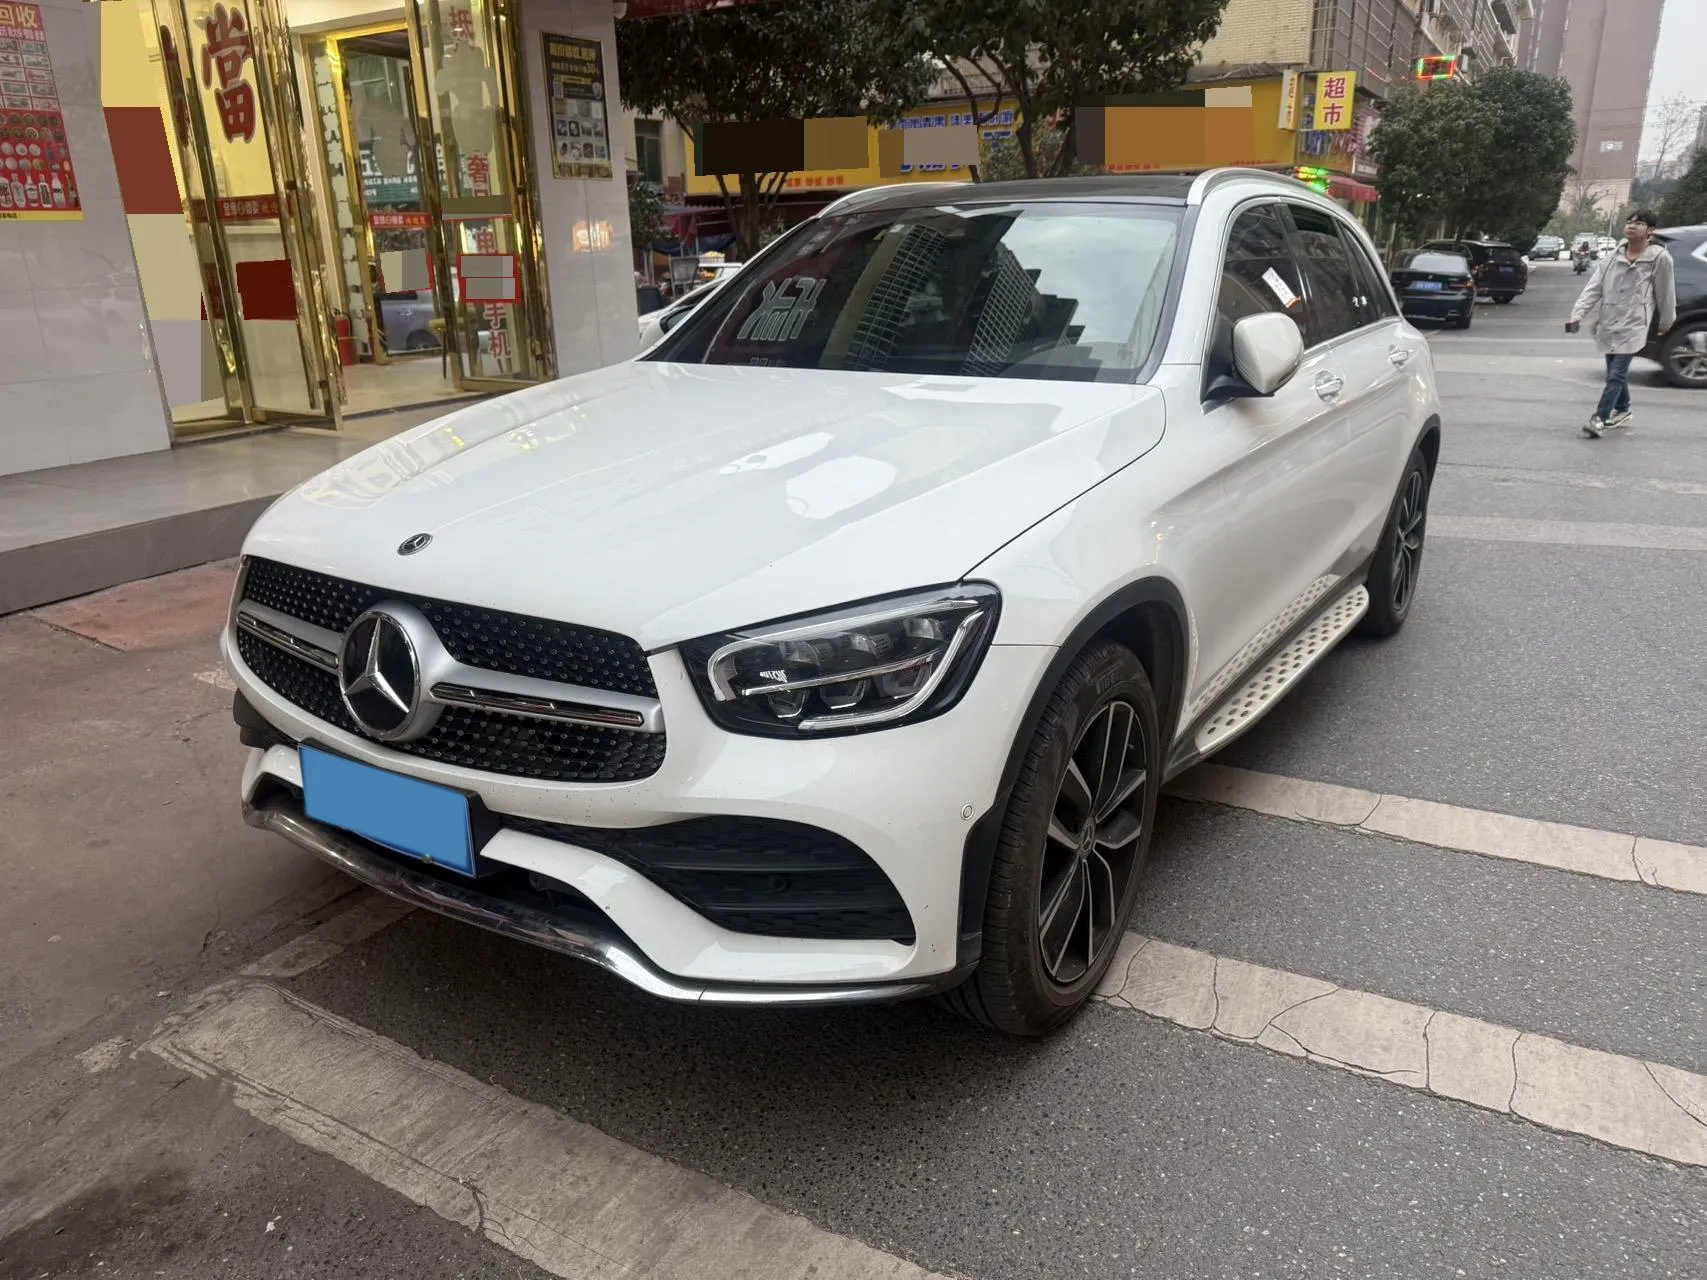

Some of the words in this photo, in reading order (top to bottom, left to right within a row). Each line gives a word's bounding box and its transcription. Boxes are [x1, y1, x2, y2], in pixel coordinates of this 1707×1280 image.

[1322, 76, 1346, 125] 超市
[467, 153, 490, 196] 奢
[483, 302, 512, 358] 手机
